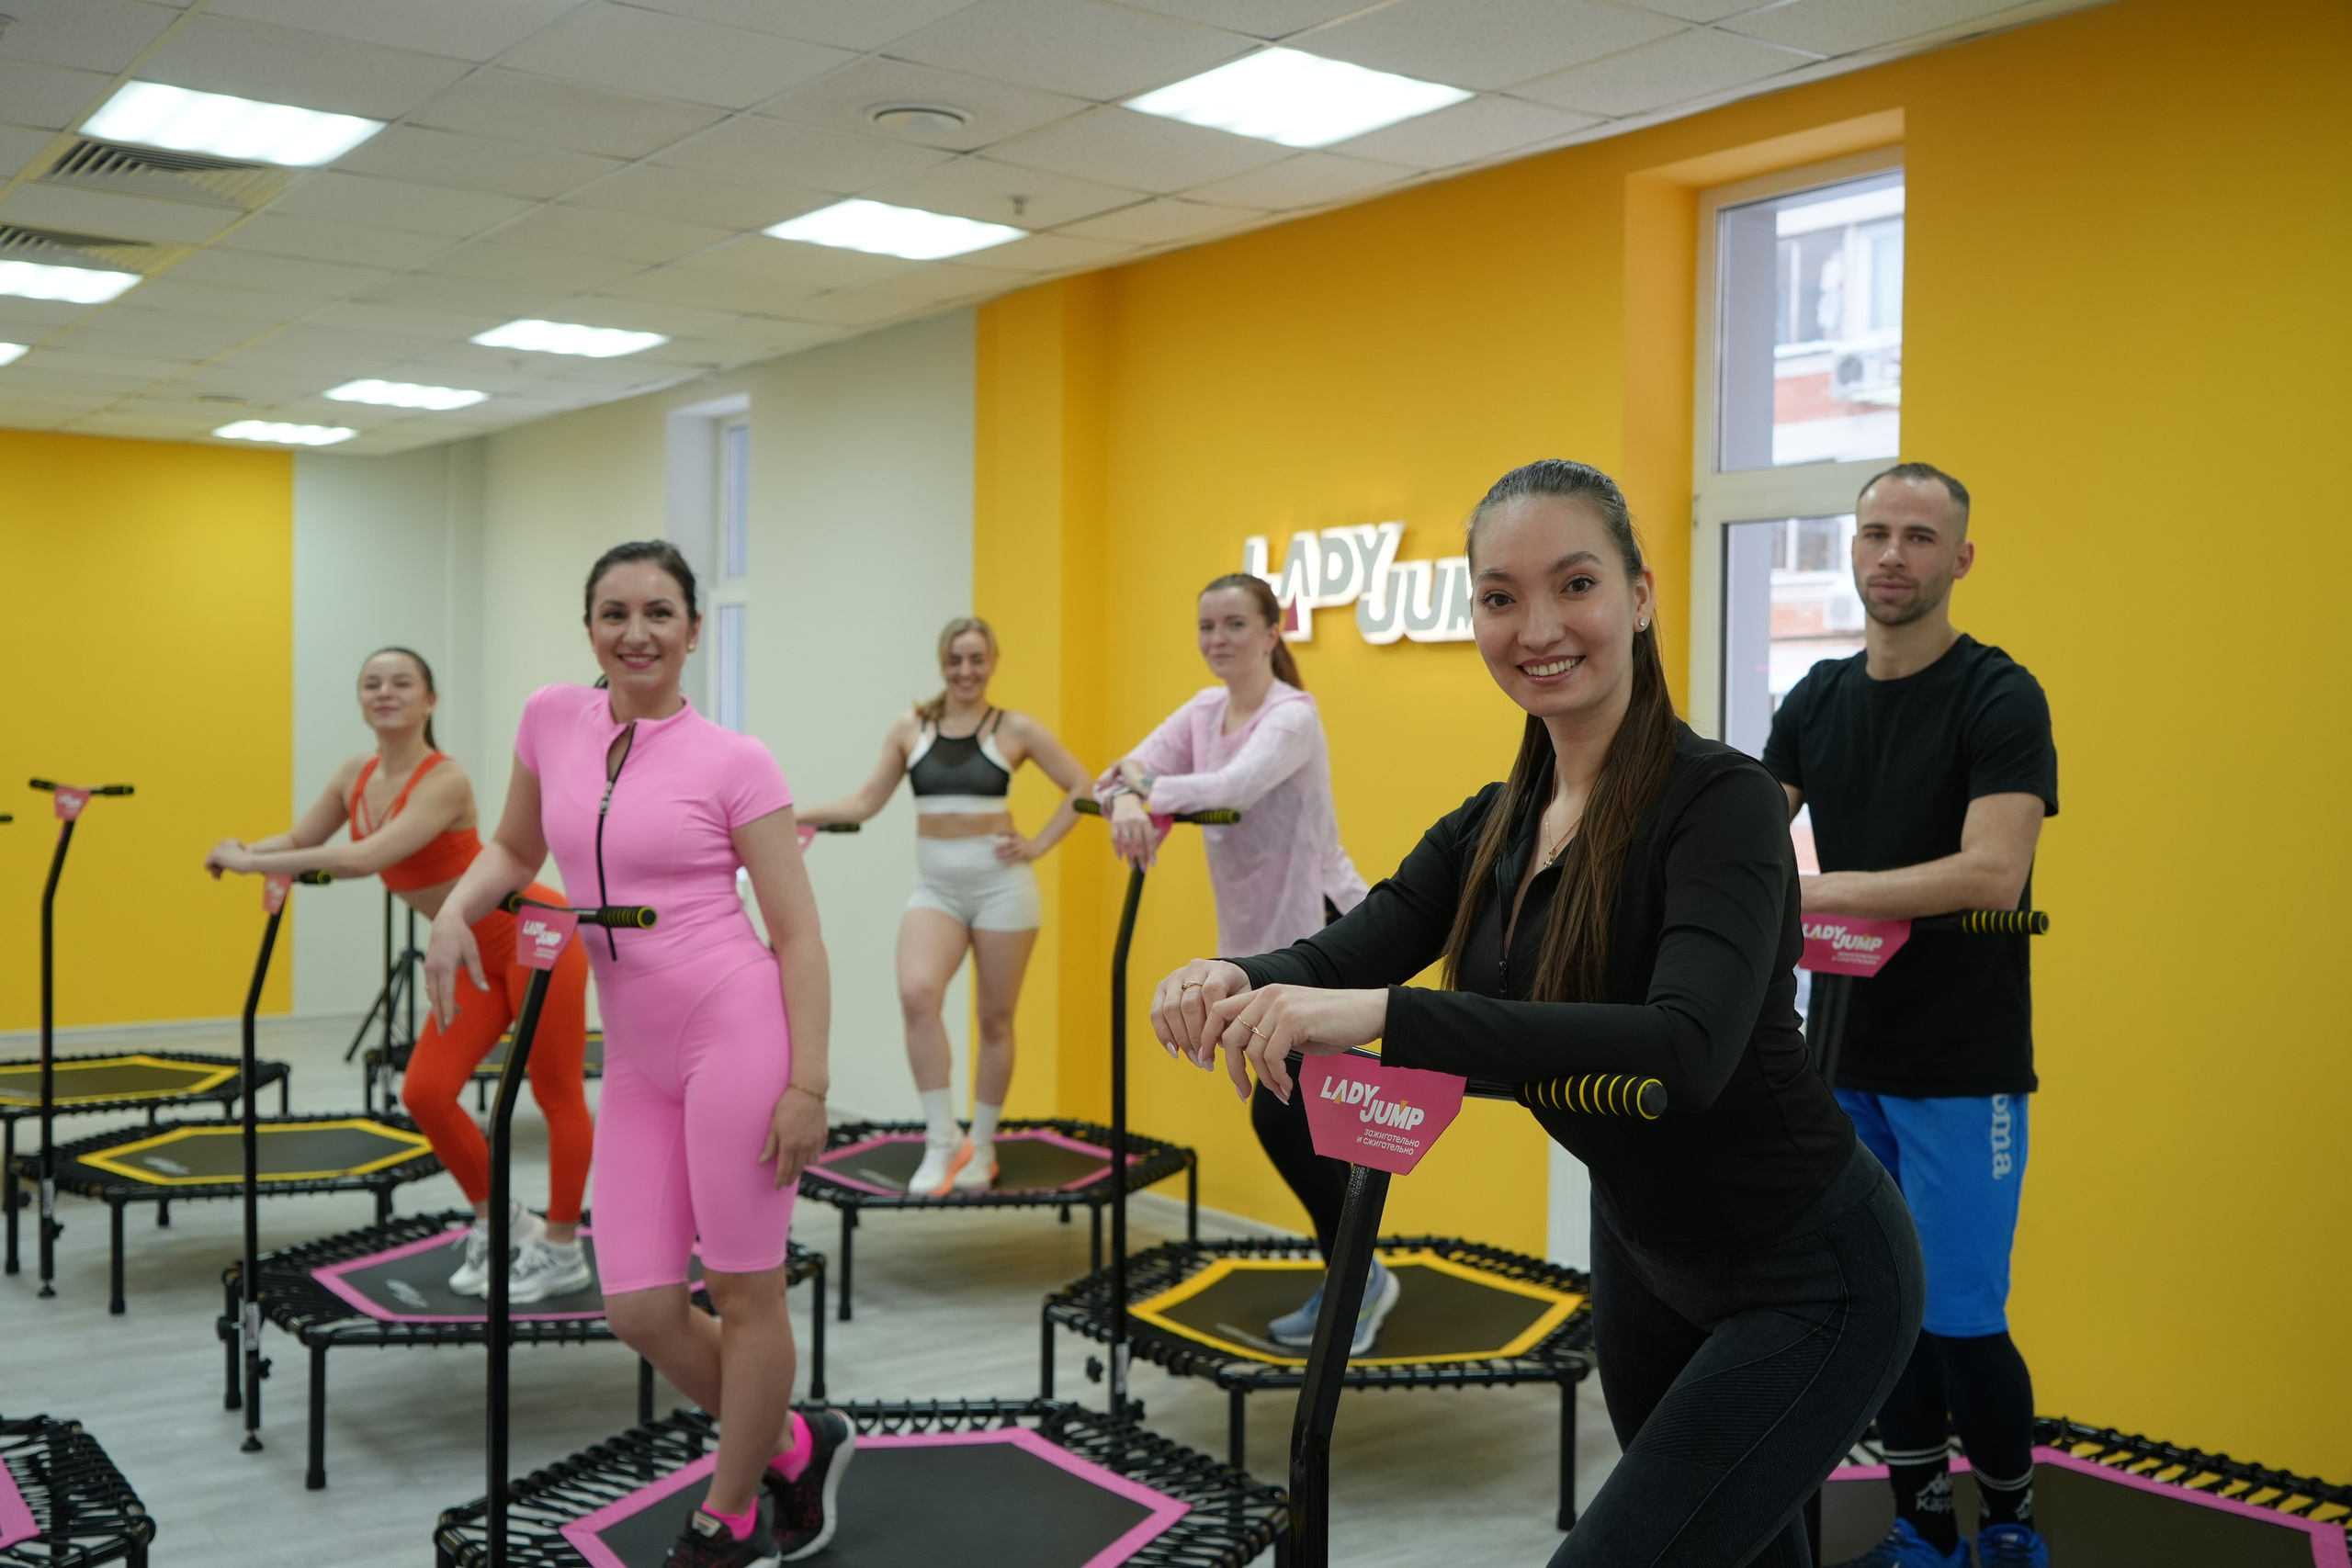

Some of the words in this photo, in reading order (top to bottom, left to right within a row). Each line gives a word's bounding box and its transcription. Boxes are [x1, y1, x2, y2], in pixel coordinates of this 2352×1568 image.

[1832, 933, 1883, 951] JUMP
[1320, 1077, 1380, 1107] LADY
[1360, 1100, 1424, 1131] JUMP
[1363, 1128, 1420, 1148] зажигательно
[1363, 1136, 1414, 1156] сжигательно
[1991, 1094, 2012, 1180] oma
